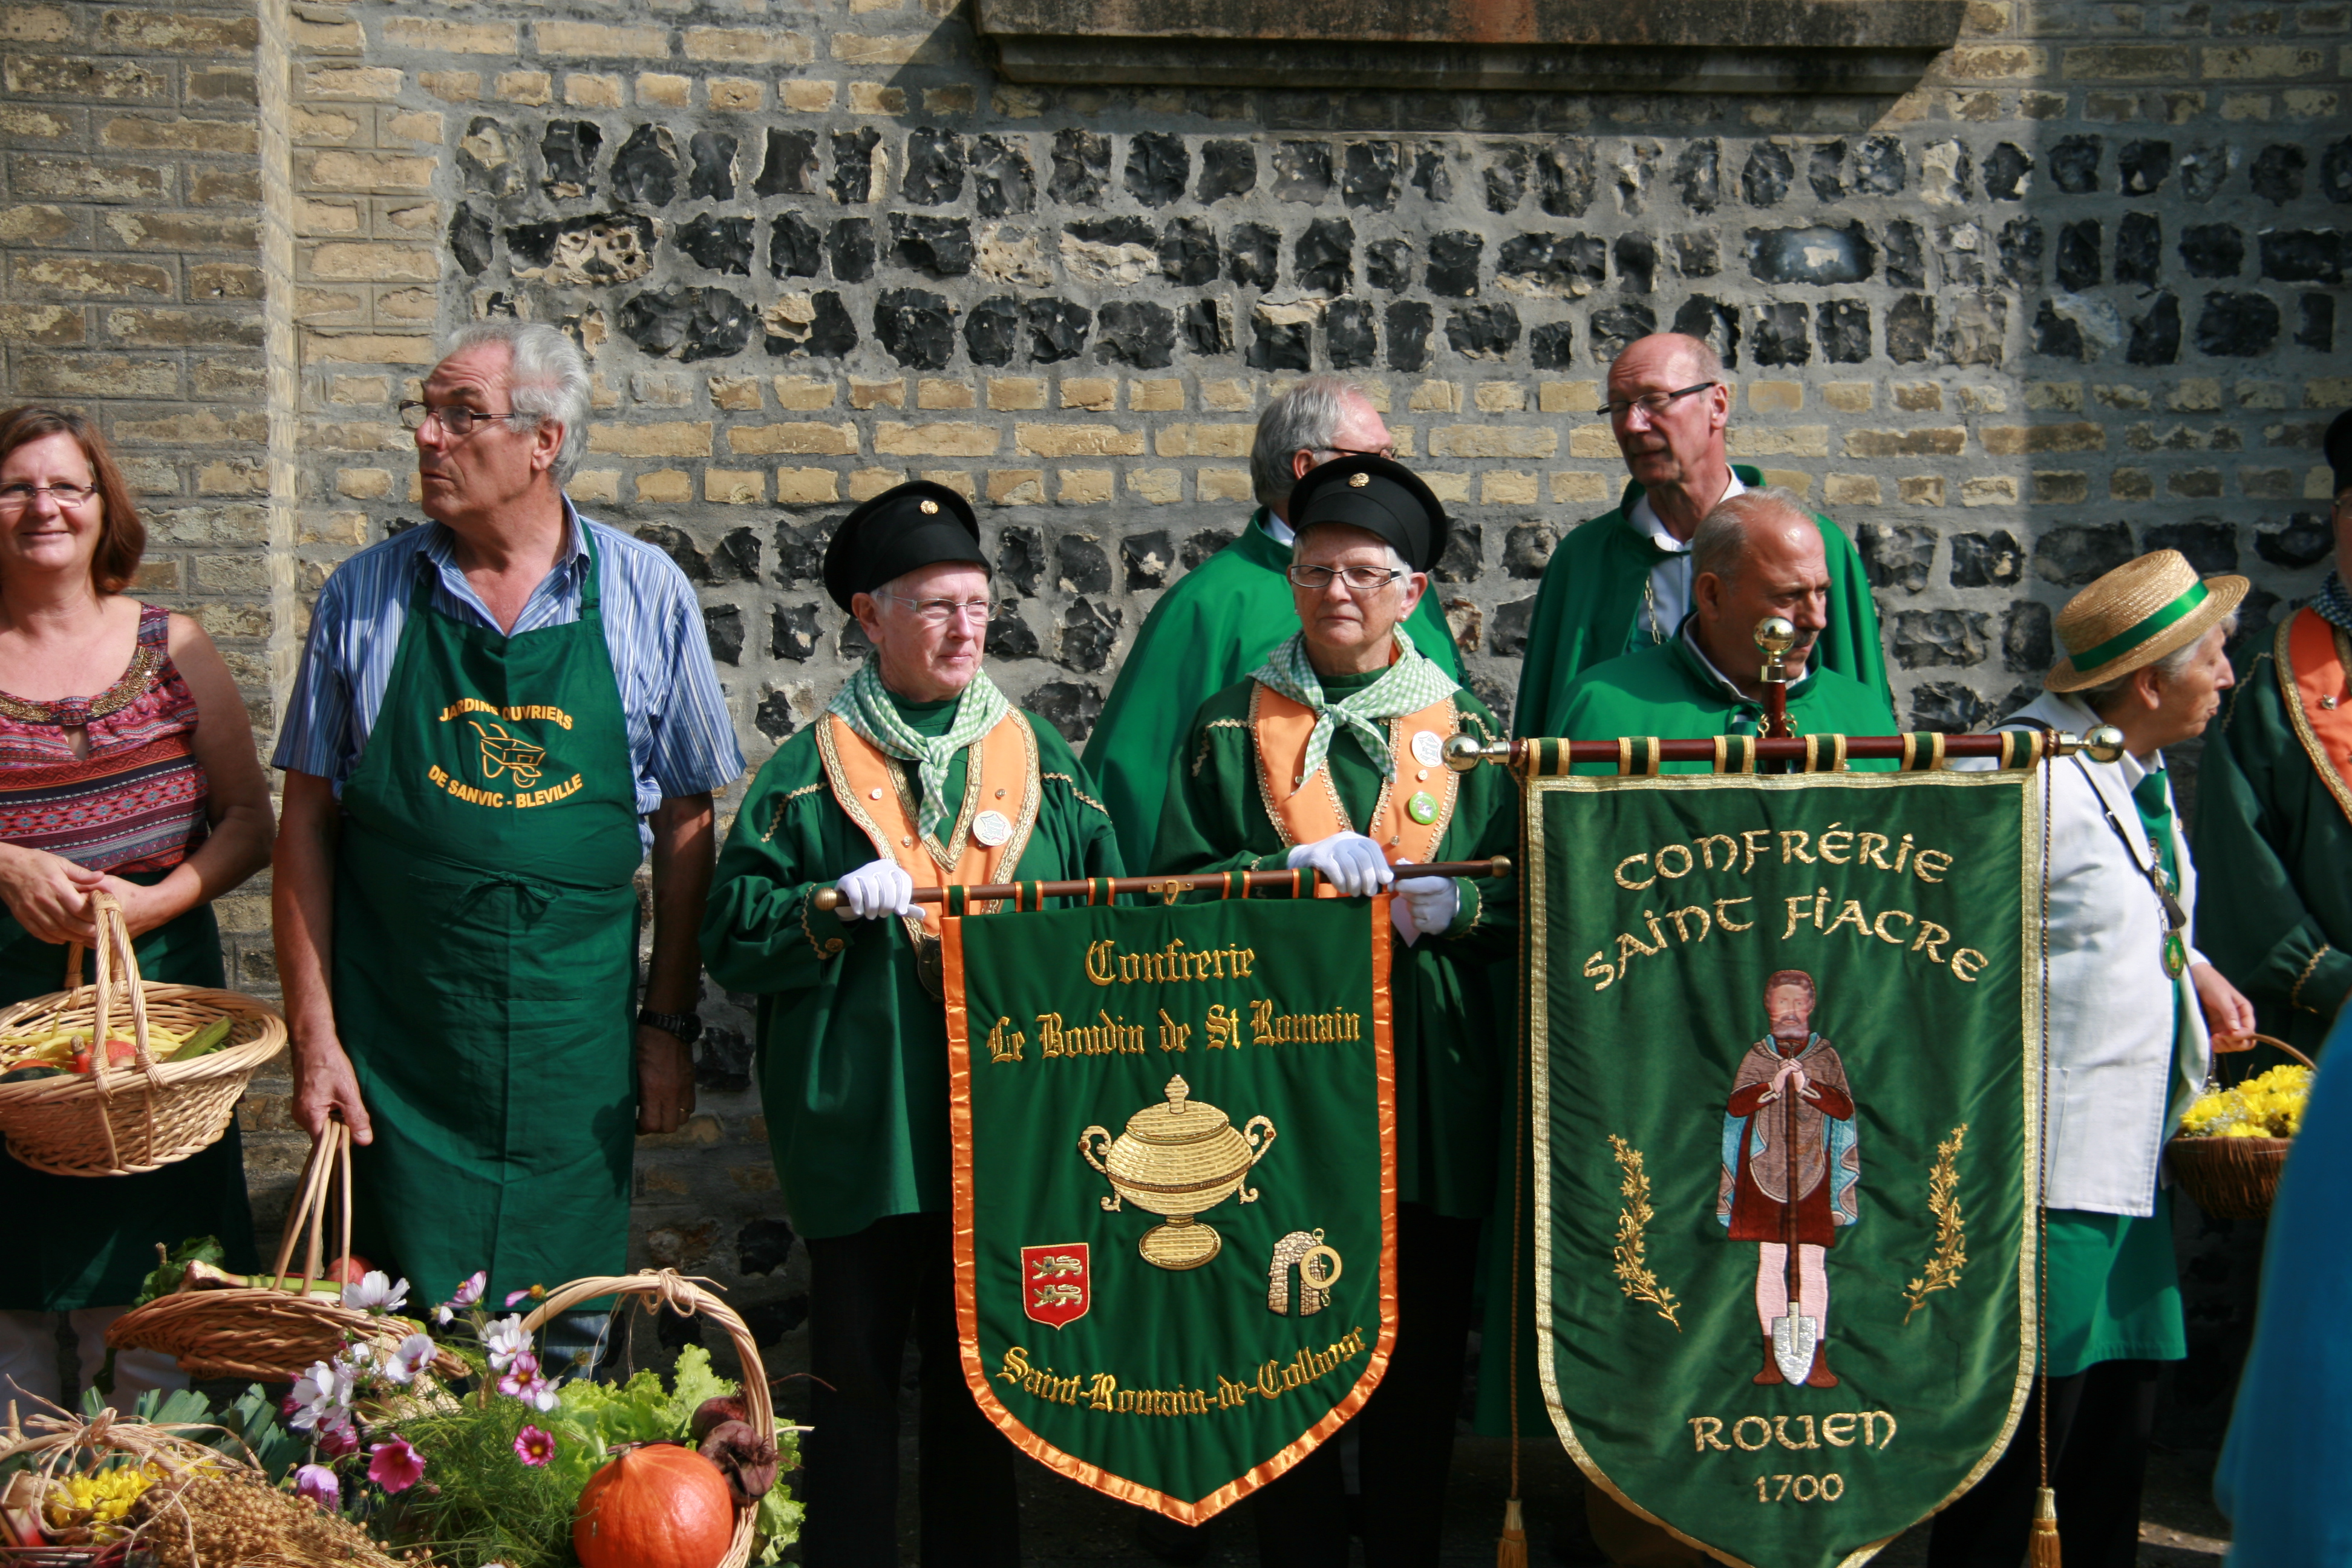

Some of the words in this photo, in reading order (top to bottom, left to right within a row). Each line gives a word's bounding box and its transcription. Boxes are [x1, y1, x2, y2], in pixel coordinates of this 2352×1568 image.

[439, 697, 499, 722] JARDINS
[502, 705, 573, 731] OUVRIERS
[428, 765, 449, 788] DE
[448, 779, 504, 808] SANVIC
[516, 773, 583, 808] BLEVILLE
[1085, 938, 1256, 986] Confrerie
[986, 1016, 1025, 1063] Le
[1036, 1008, 1145, 1059] Boudin
[1158, 1008, 1191, 1053] de
[1205, 1004, 1242, 1051] St
[1249, 998, 1361, 1047] Romain
[1688, 1410, 1897, 1452] ROUEN
[1754, 1472, 1845, 1503] 1700
